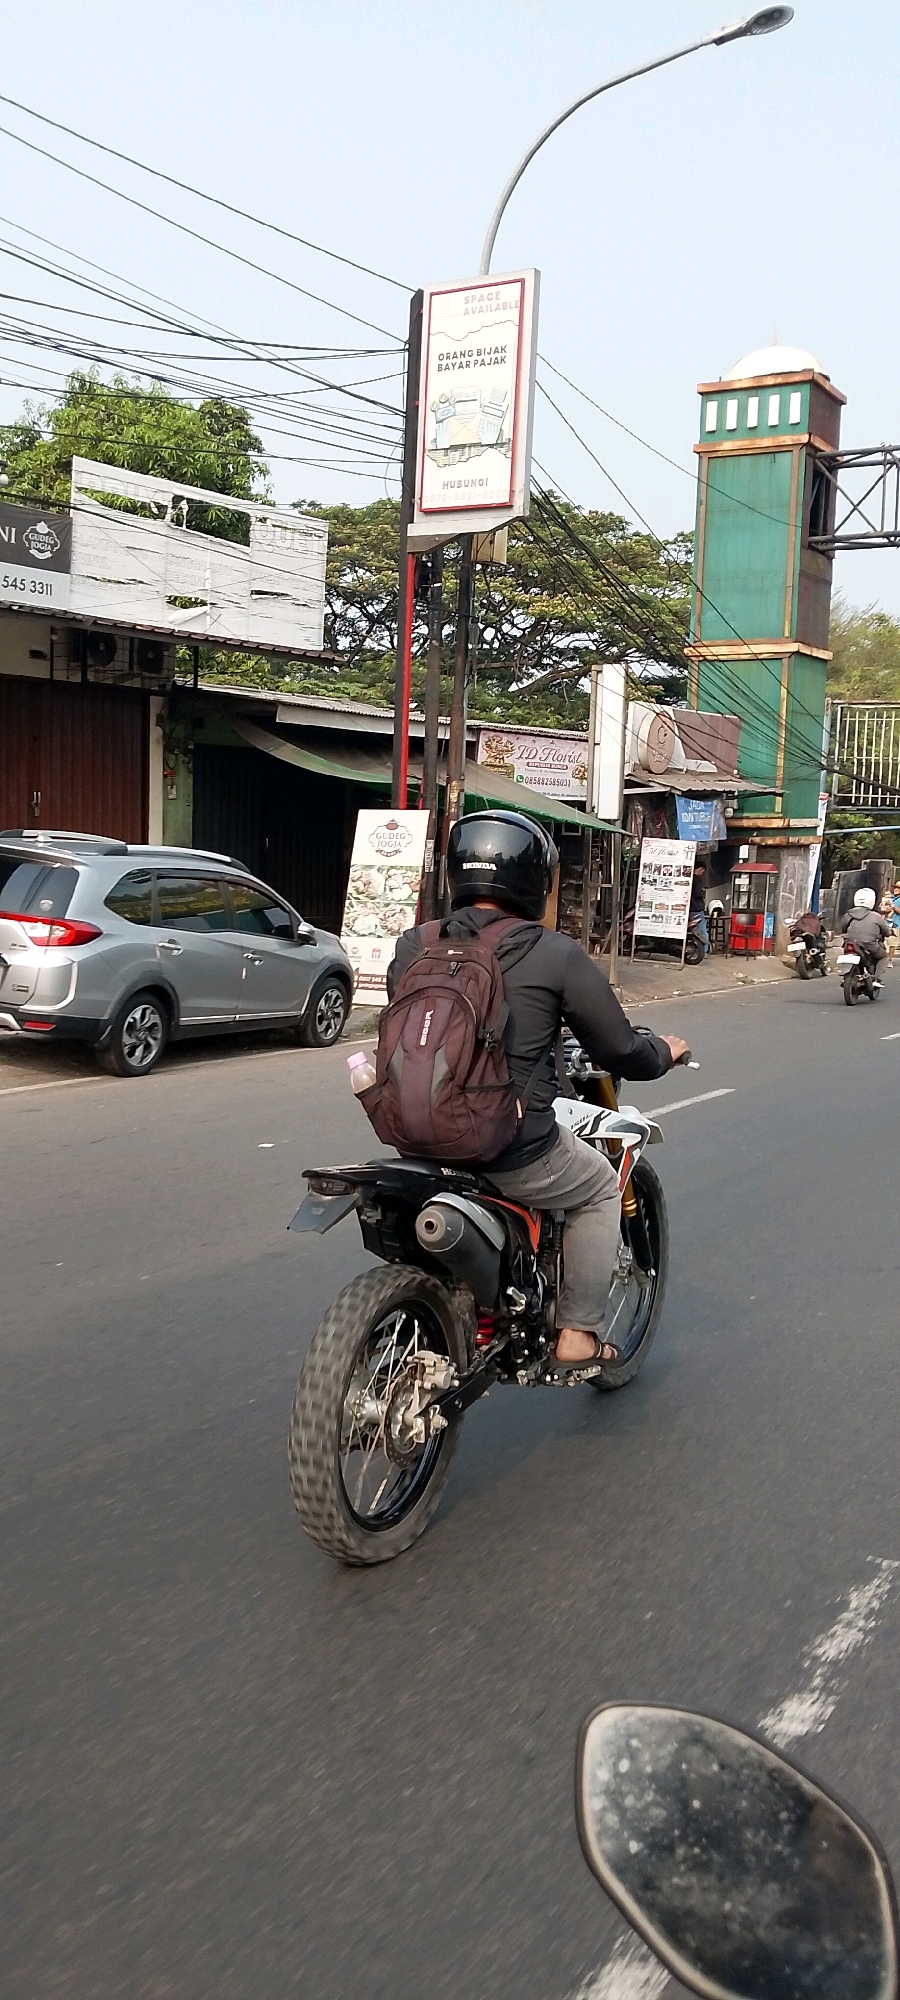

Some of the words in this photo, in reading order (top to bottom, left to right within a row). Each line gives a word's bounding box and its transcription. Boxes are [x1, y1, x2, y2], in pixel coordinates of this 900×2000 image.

[463, 291, 501, 304] SPACE
[463, 300, 520, 316] AVAILABLE
[437, 348, 474, 361] ORANG
[476, 345, 508, 358] BIJAK
[437, 359, 472, 372] BAYAR
[473, 355, 507, 369] PAJAK
[442, 478, 489, 489] HUBUNGI
[28, 532, 55, 544] GUDEG
[30, 541, 52, 551] JOGJA
[1, 575, 26, 591] 545
[29, 580, 53, 596] 3311
[539, 747, 582, 765] Florist
[375, 832, 406, 840] GUDEG
[377, 840, 402, 848] JOGJA
[462, 862, 498, 871] HONDA
[440, 1167, 476, 1181] HONDA
